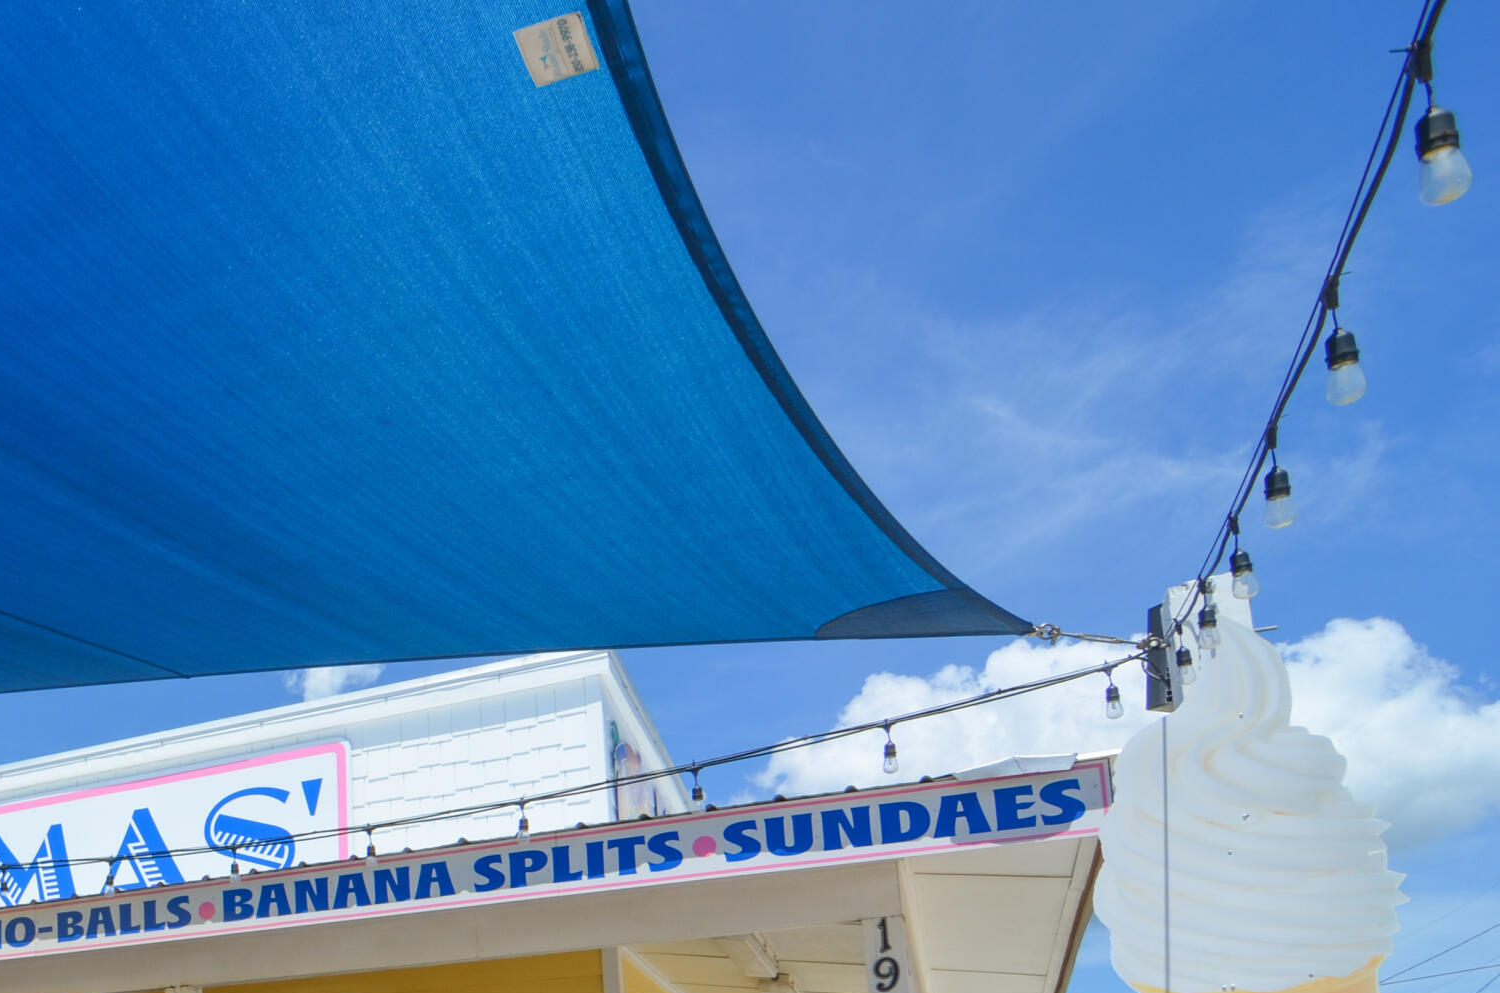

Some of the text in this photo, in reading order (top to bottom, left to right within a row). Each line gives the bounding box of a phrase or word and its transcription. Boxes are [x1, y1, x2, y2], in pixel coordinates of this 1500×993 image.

[221, 860, 456, 923] BANANA
[473, 830, 685, 894] SPLITS
[723, 778, 1087, 863] SUNDAES
